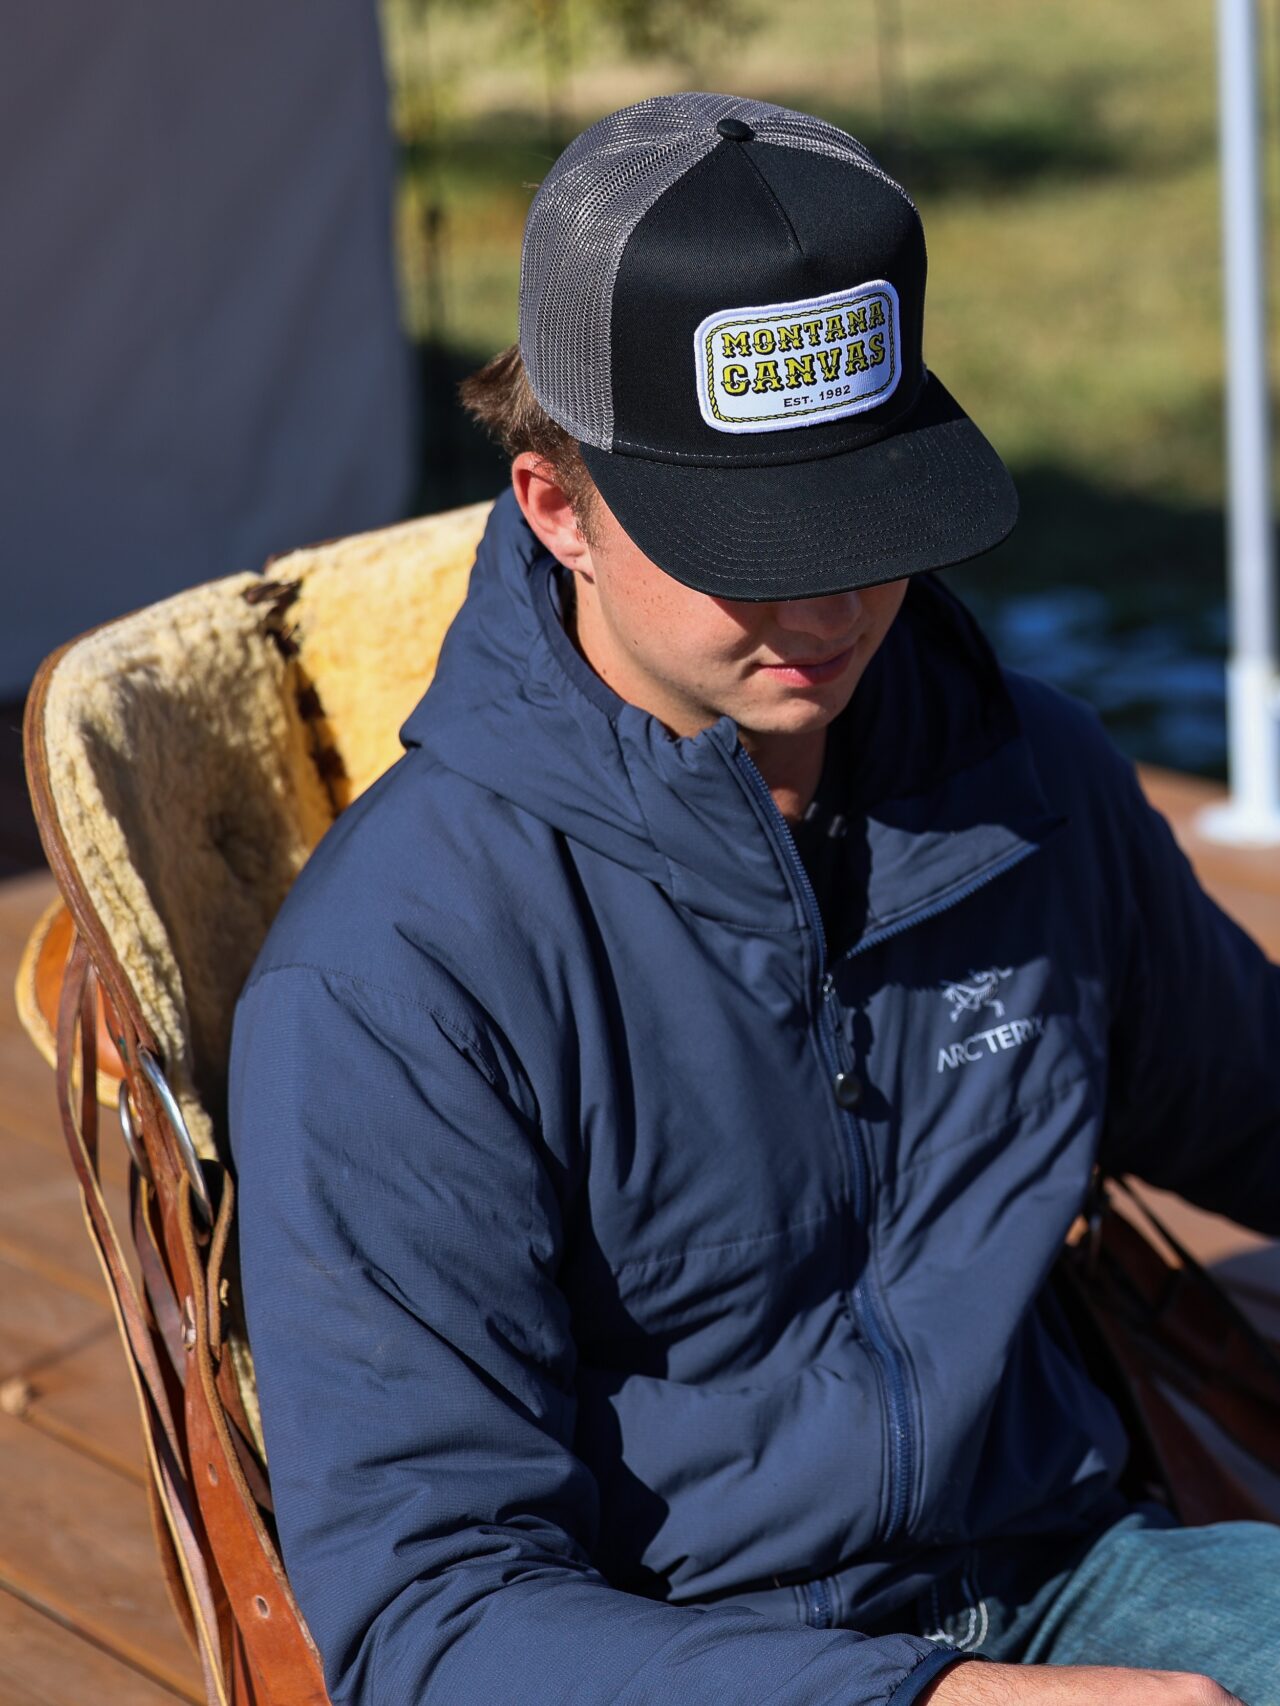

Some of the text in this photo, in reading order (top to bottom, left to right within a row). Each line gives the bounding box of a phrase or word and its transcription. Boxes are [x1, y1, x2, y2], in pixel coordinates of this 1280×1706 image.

[721, 302, 886, 358] MONTANA
[721, 332, 886, 396] CANVAS
[819, 385, 851, 401] 1982
